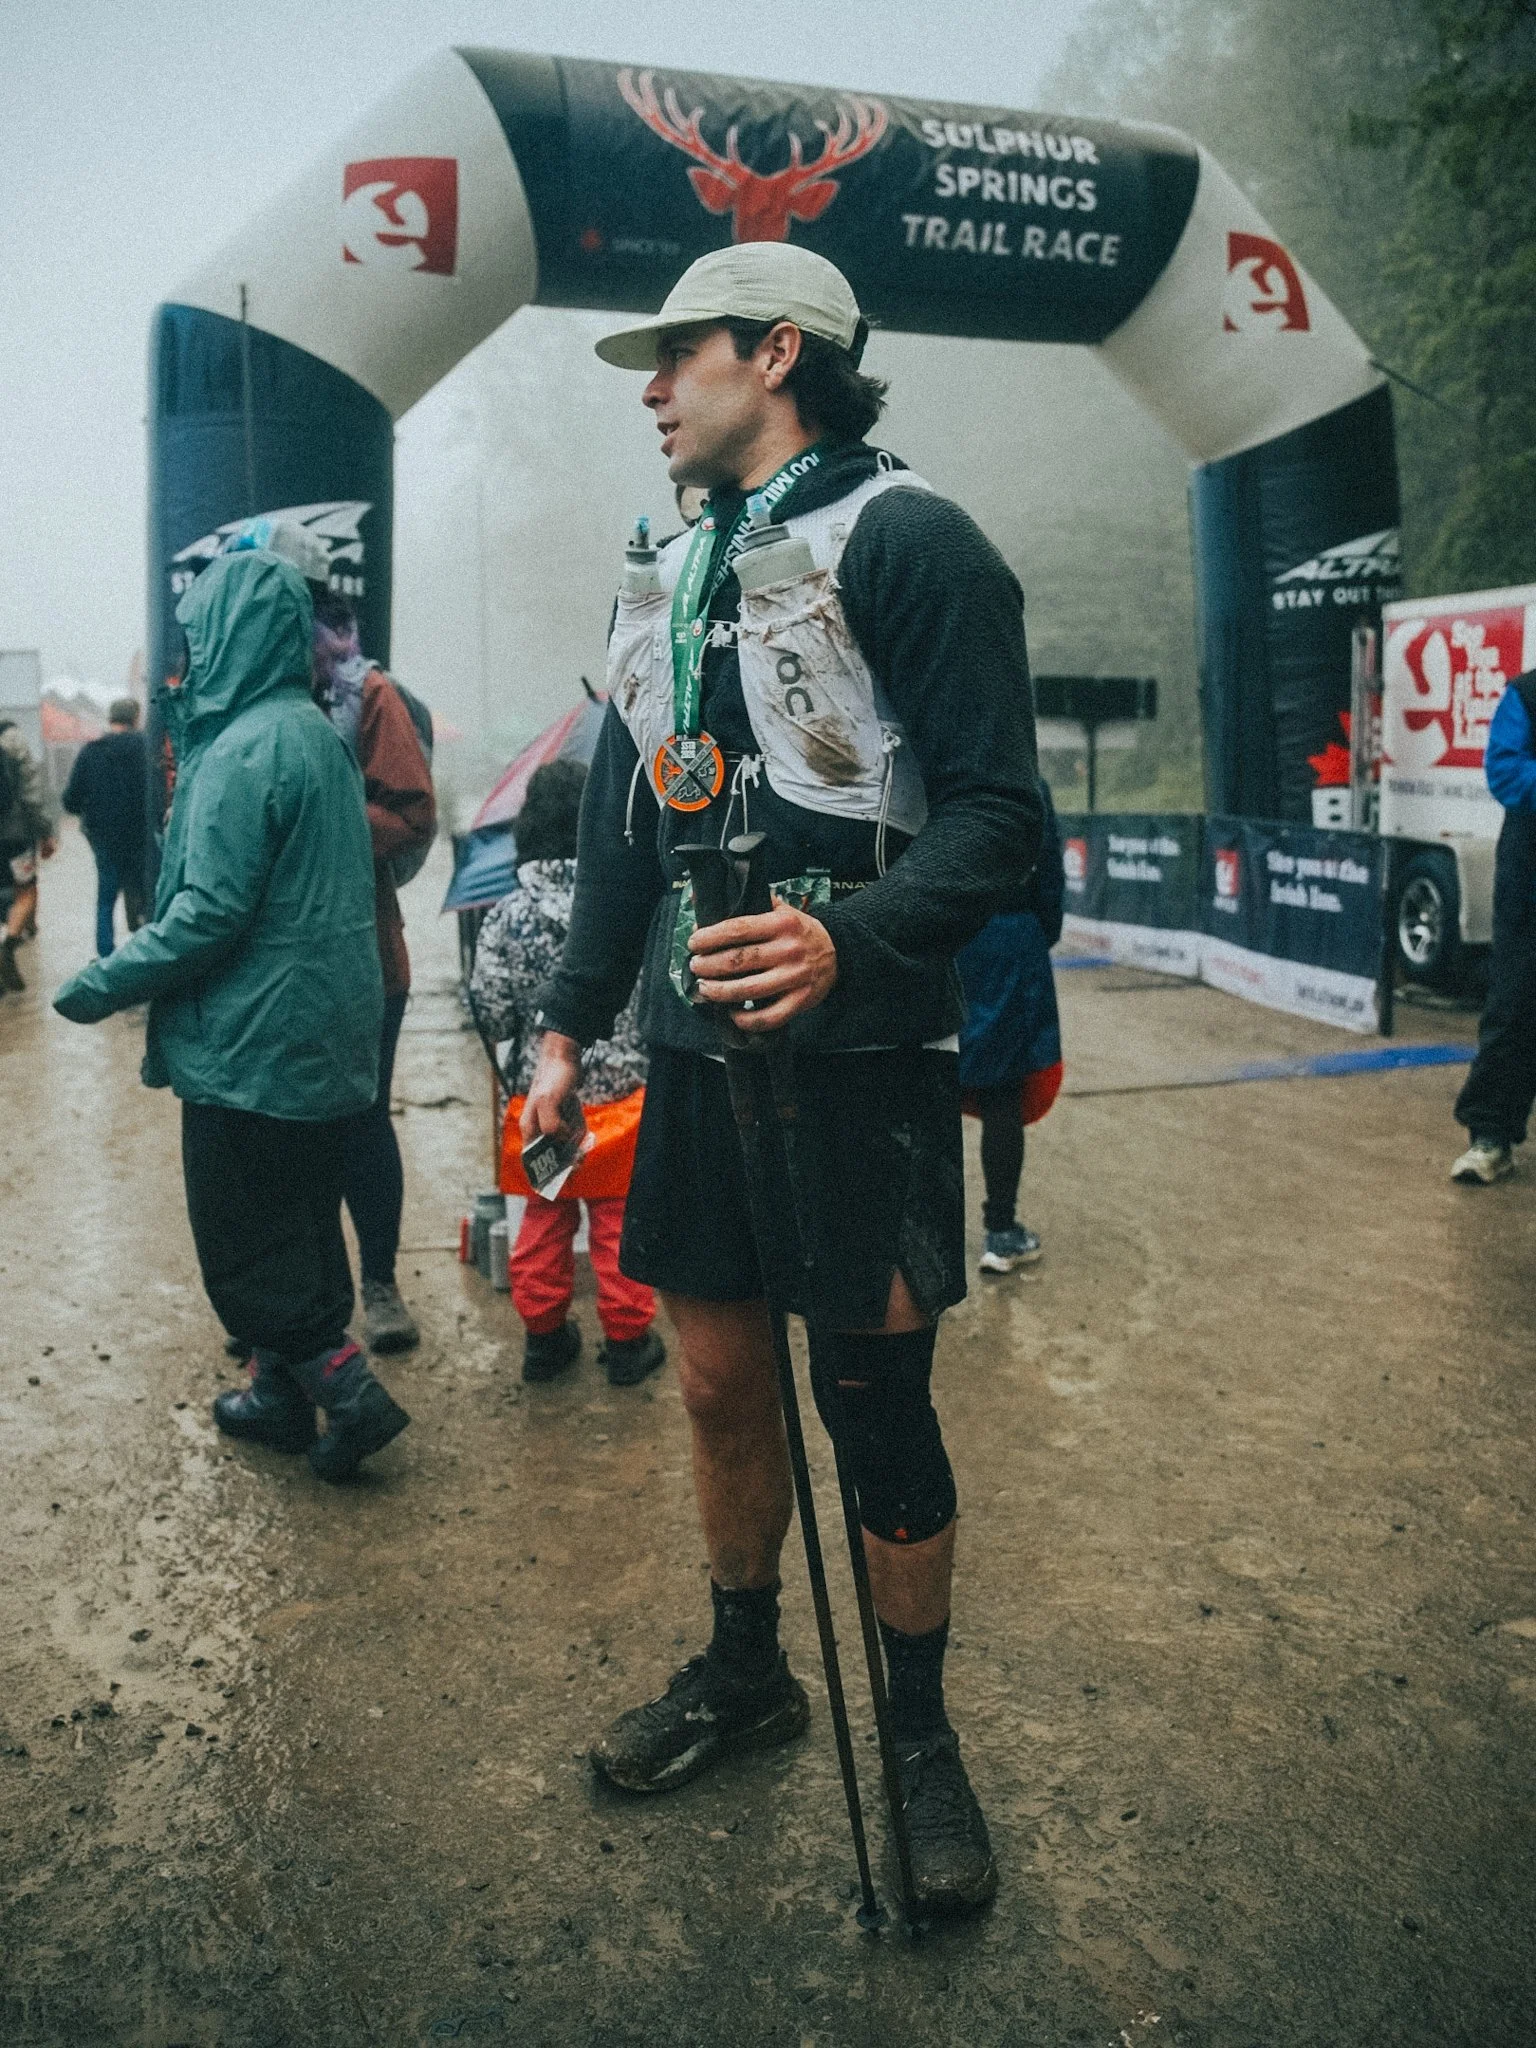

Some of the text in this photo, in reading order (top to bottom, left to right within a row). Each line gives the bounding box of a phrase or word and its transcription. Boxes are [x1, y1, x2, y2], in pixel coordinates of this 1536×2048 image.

[920, 118, 1099, 165] SULPHUR
[934, 163, 1098, 212] SPRINGS
[902, 214, 1122, 267] TRAIL RACE
[1272, 588, 1326, 611] STAY
[1332, 586, 1370, 605] OUT
